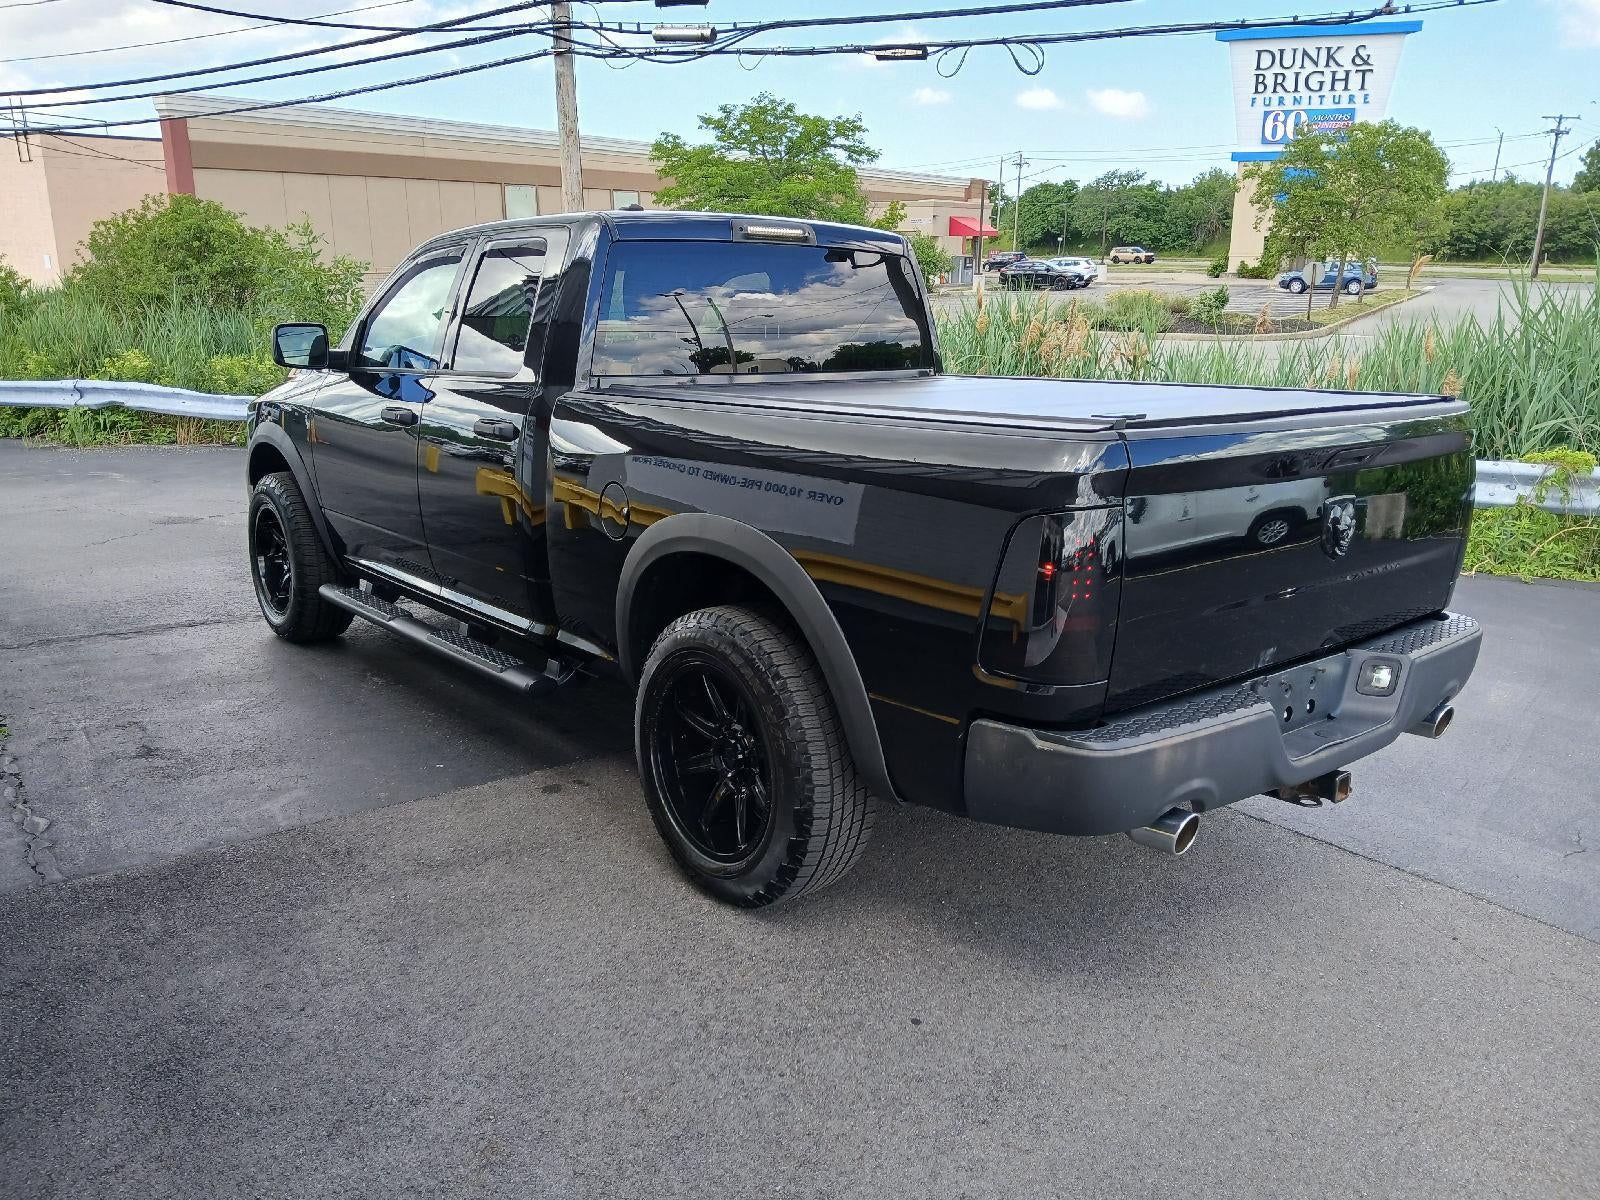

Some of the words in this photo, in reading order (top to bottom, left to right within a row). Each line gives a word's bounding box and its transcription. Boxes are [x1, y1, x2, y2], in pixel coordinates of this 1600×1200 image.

[1255, 45, 1344, 71] DUNK
[1351, 44, 1374, 67] &
[1253, 69, 1374, 94] BRIGHT
[1251, 93, 1371, 107] FURNITURE
[1264, 110, 1309, 142] 60
[1312, 113, 1352, 121] MONTHS
